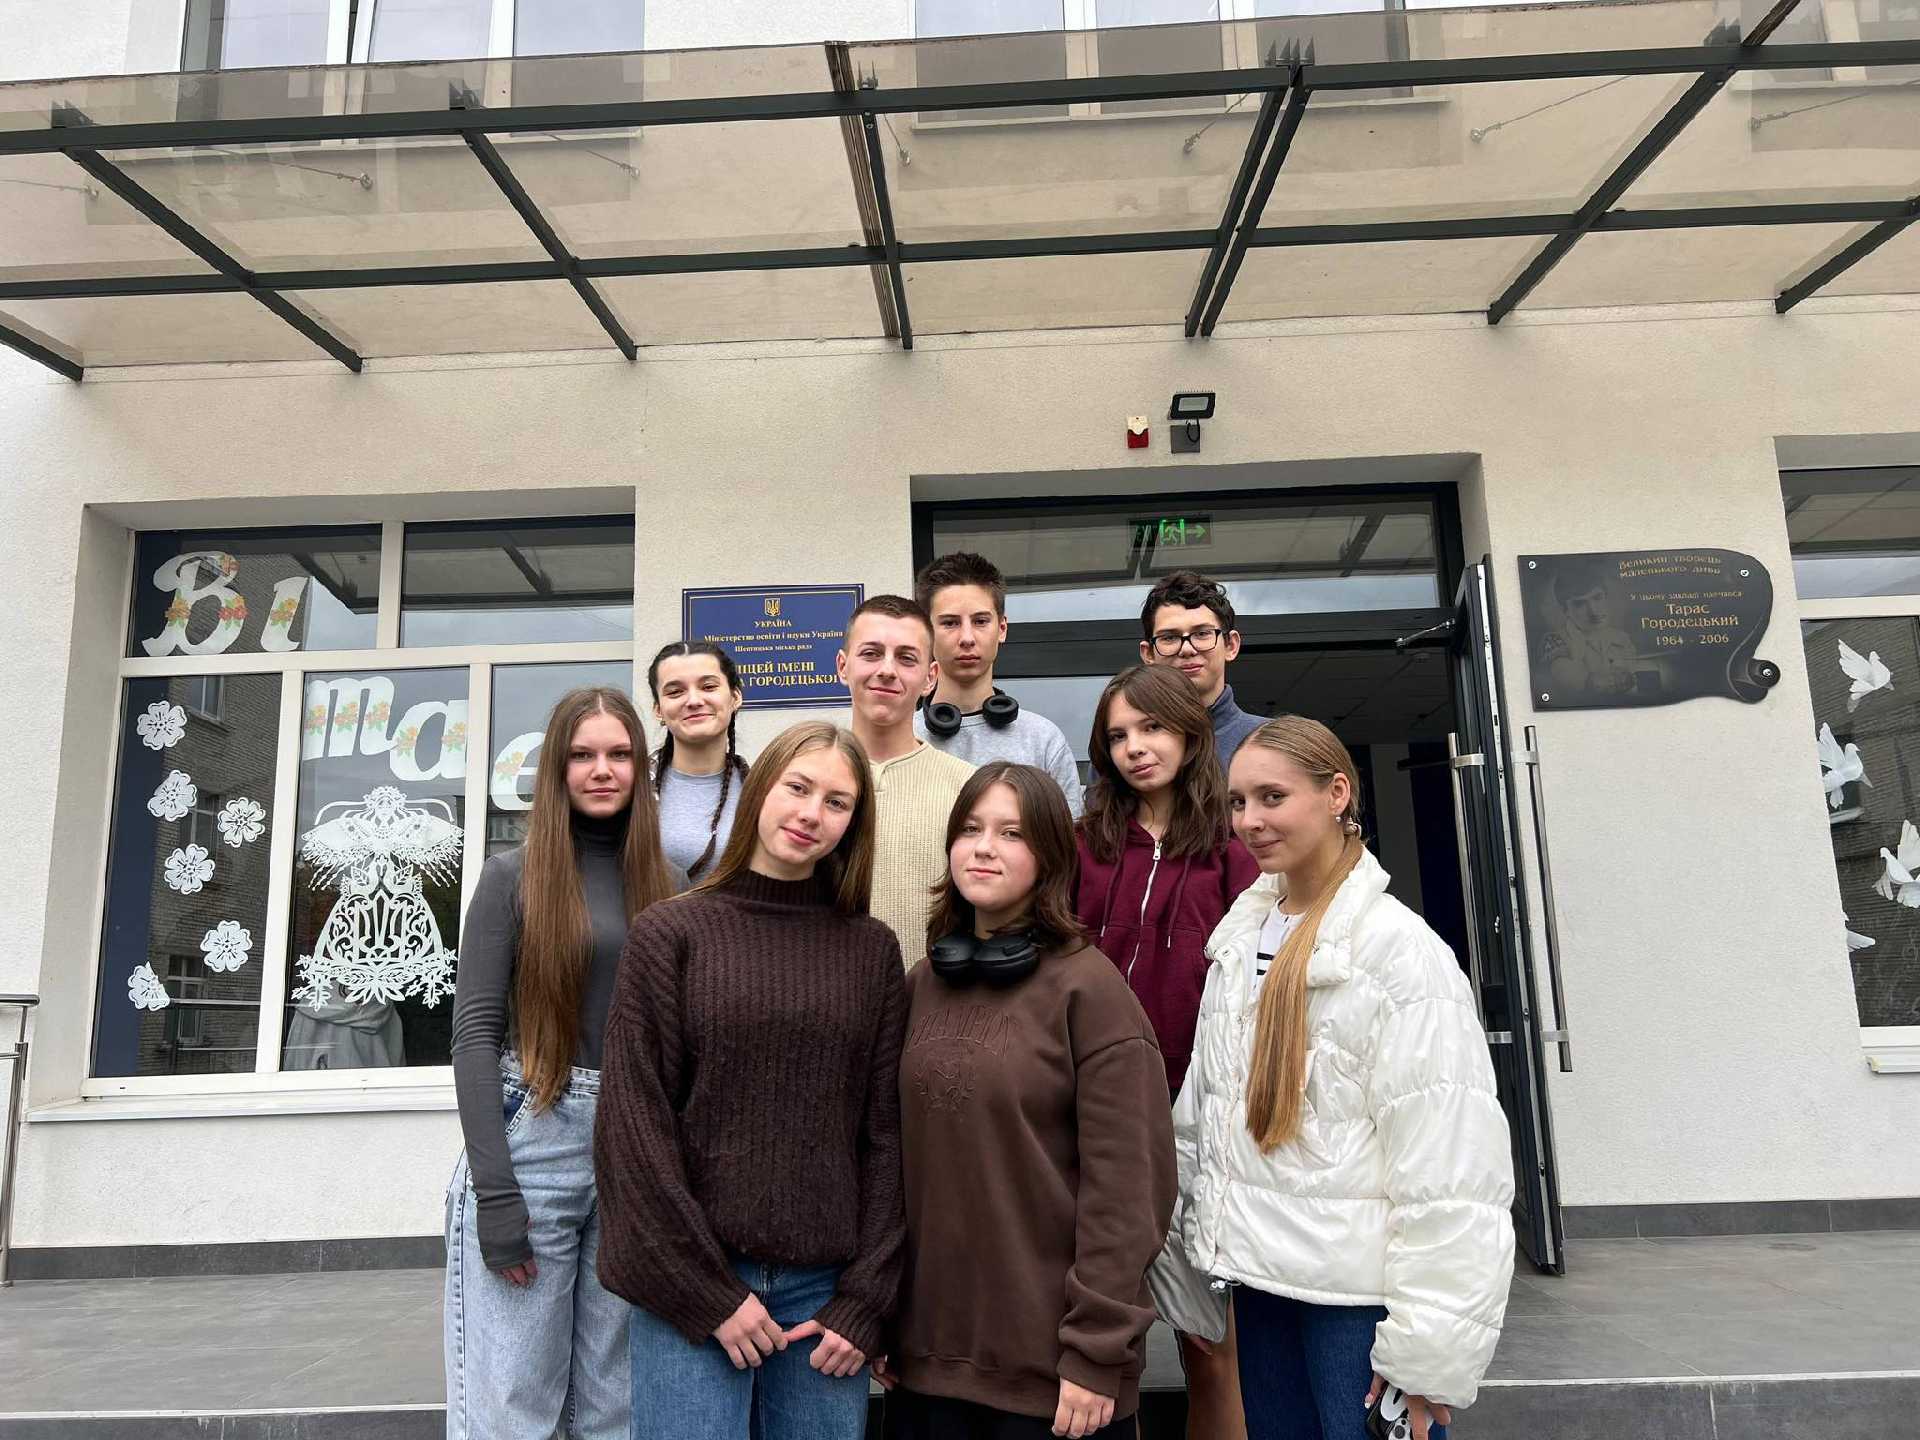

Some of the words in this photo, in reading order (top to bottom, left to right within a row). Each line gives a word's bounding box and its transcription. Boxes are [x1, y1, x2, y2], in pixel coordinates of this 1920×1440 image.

[1666, 604, 1711, 617] Тарас
[754, 619, 792, 628] УКРАЇНА
[1640, 615, 1740, 631] Городецький
[704, 633, 755, 643] Міністерство
[756, 632, 781, 641] освіти
[786, 632, 810, 641] науки
[811, 629, 844, 639] України
[1656, 634, 1684, 646] 1964
[1698, 633, 1730, 645] 2006
[777, 661, 816, 673] ІМЕНІ
